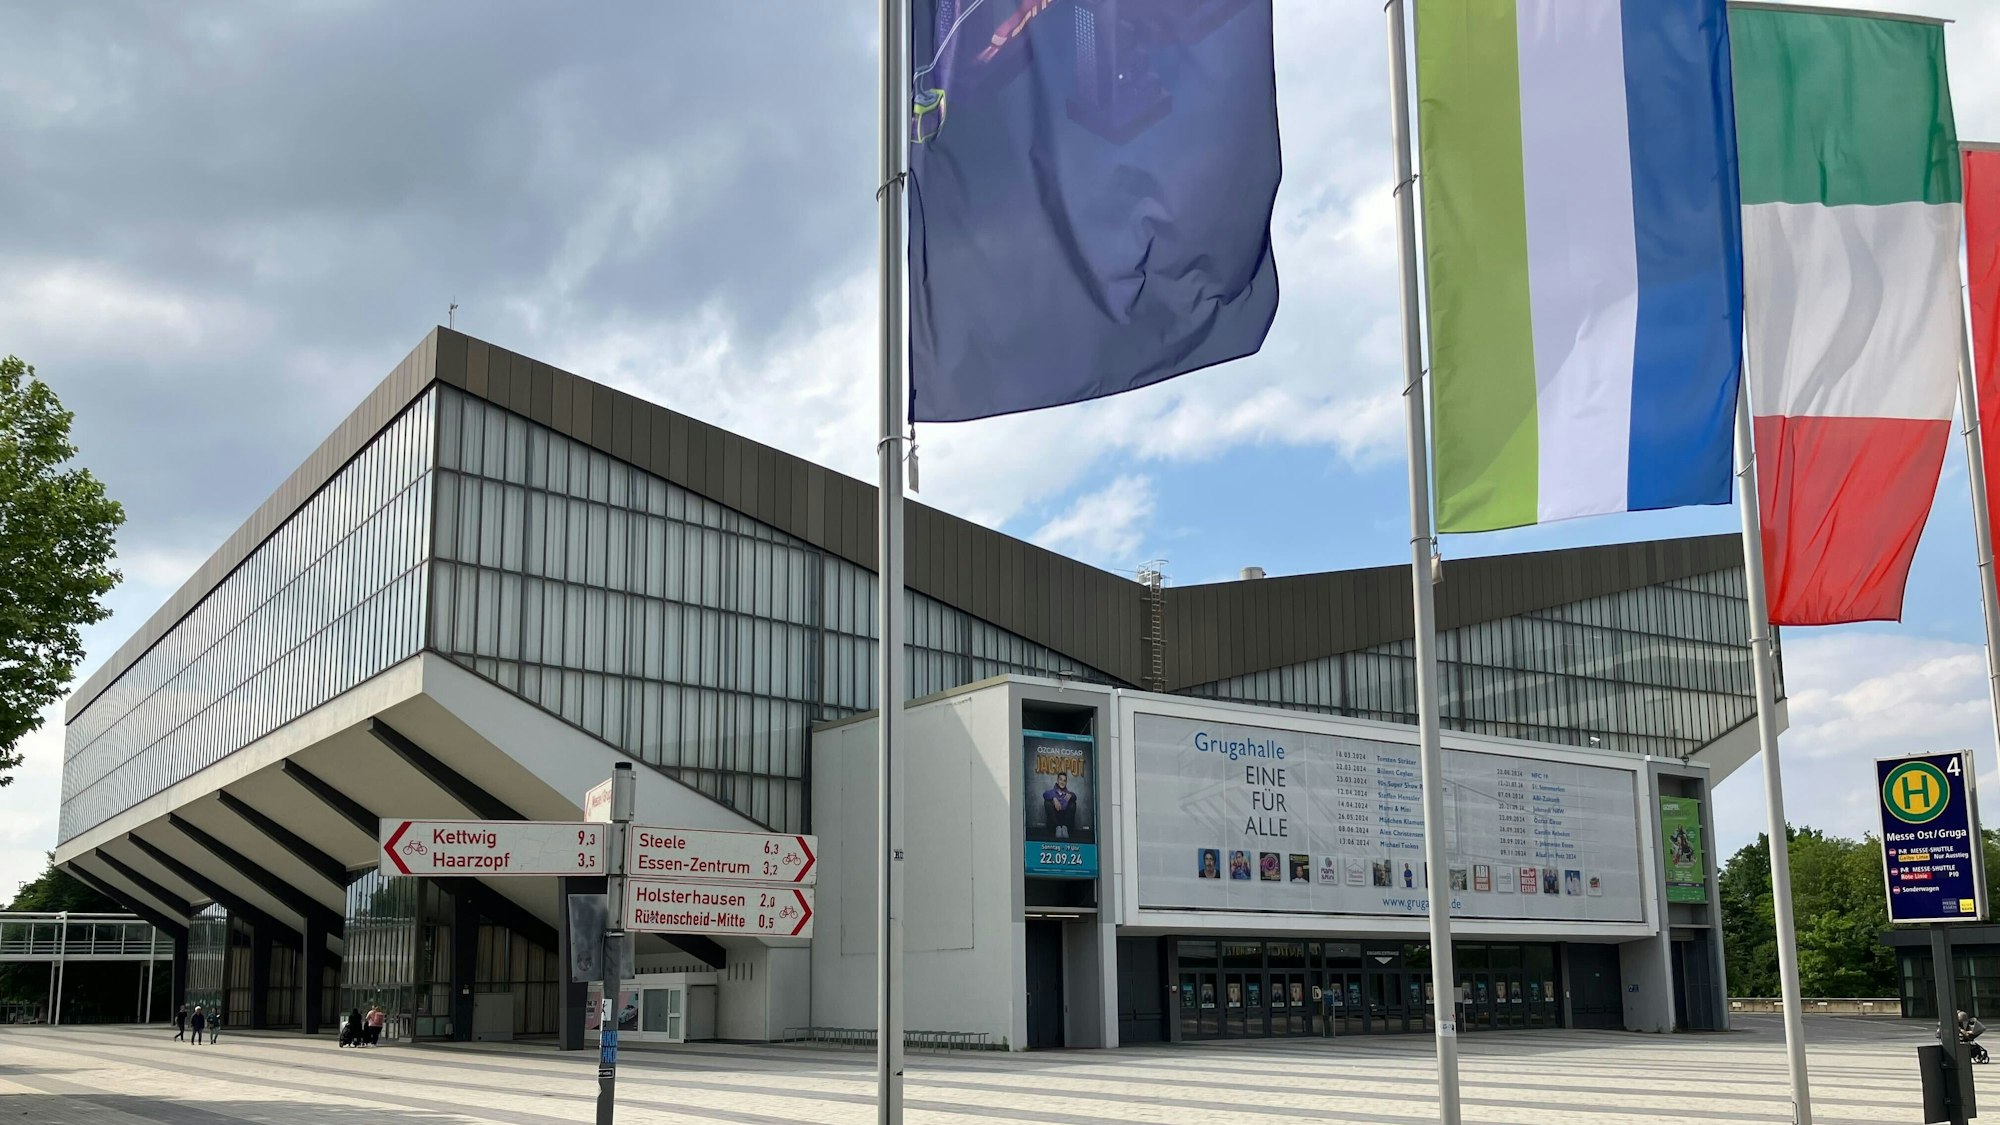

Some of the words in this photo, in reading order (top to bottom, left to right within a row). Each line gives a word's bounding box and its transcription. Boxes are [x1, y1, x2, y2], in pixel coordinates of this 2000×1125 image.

[1194, 732, 1285, 760] Grugahalle
[1035, 754, 1085, 777] JACKPOT
[1946, 757, 1961, 777] 4
[1245, 766, 1286, 788] EINE
[1252, 789, 1287, 812] FÜR
[1902, 775, 1930, 809] H
[1244, 817, 1288, 838] ALLE
[1887, 832, 1915, 842] Messe
[432, 828, 497, 848] Kettwig
[578, 830, 596, 846] 9,3
[639, 833, 686, 850] Steele
[764, 841, 779, 856] 6,3
[1041, 844, 1061, 852] Sonntag
[432, 852, 510, 870] Haarzopf
[578, 853, 596, 868] 3,5
[638, 855, 750, 874] Essen-Zentrum
[763, 861, 778, 876] 3,2
[1040, 852, 1082, 864] 22.09.24
[636, 888, 746, 906] Holsterhausen
[760, 894, 776, 908] 2,0
[635, 909, 746, 928] Rüttenscheid-Mitte
[758, 914, 774, 929] 0,5
